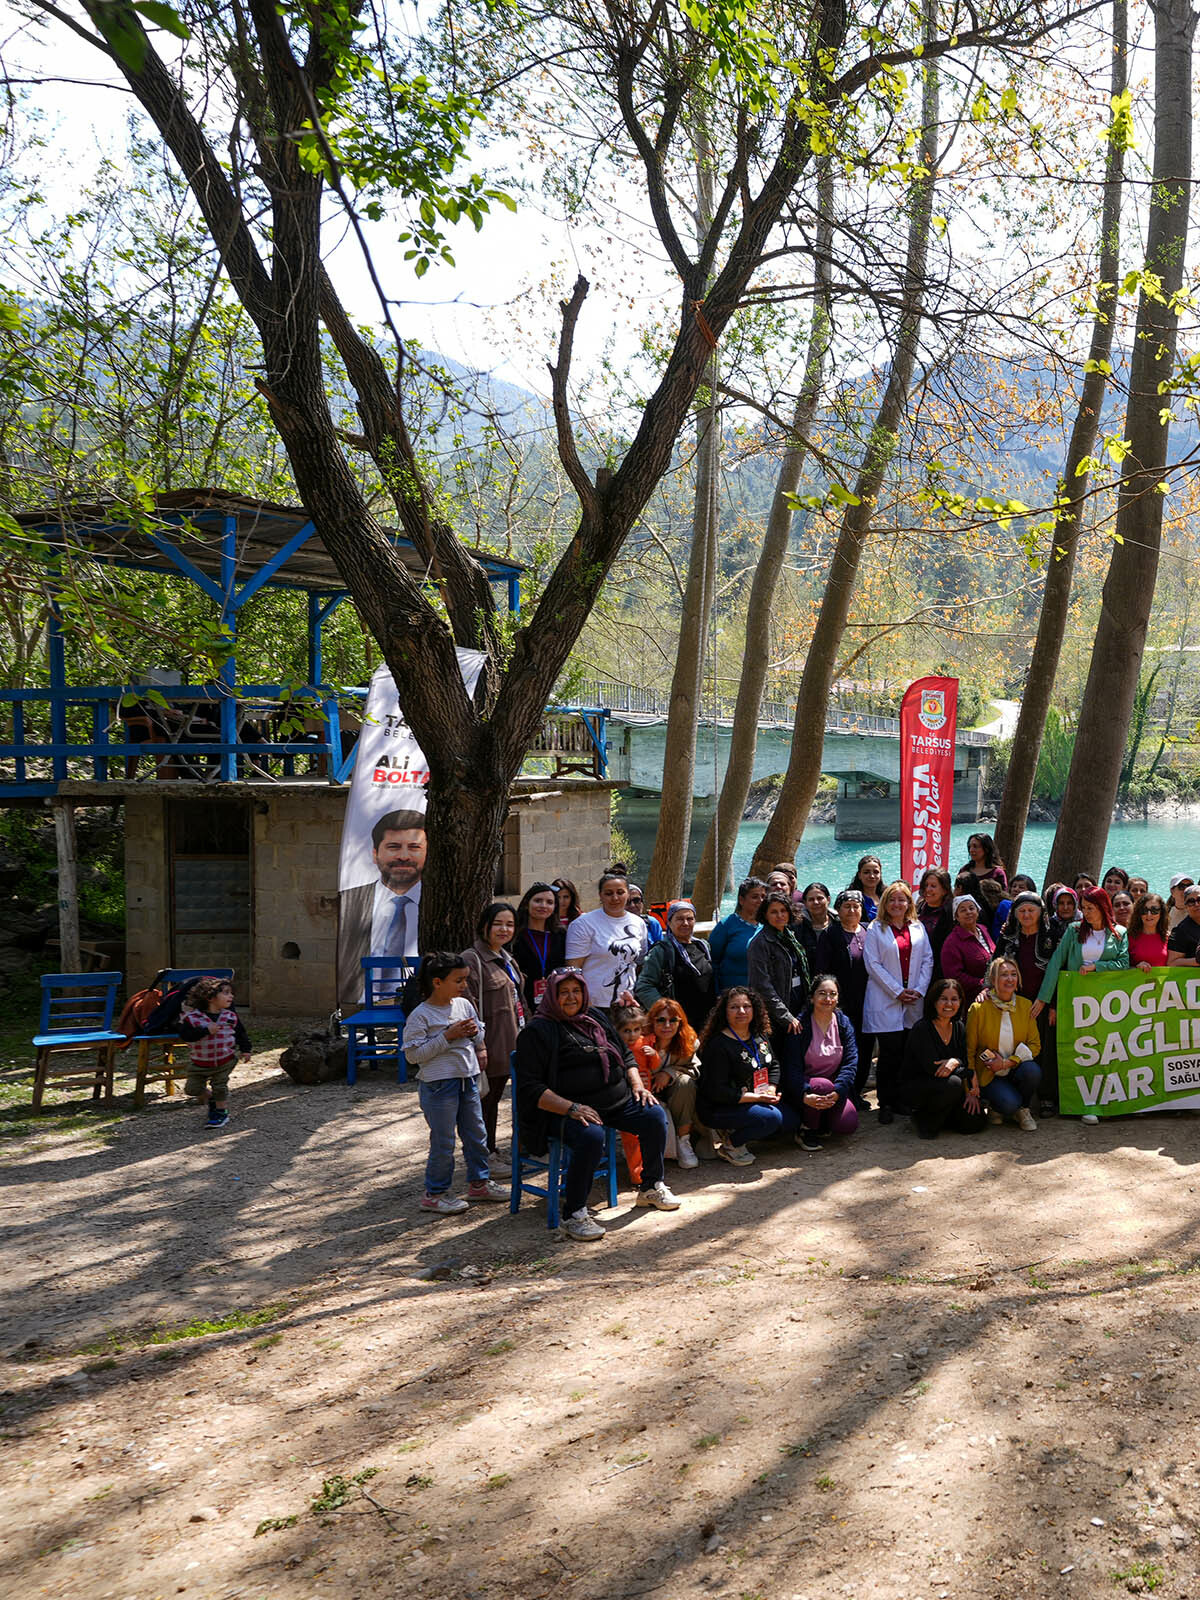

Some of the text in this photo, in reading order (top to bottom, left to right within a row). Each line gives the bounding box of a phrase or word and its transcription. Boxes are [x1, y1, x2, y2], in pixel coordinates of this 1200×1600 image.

[911, 735, 952, 749] TARSUS
[373, 770, 430, 784] BOLTA
[926, 775, 940, 814] Var
[1075, 1066, 1156, 1106] VAR
